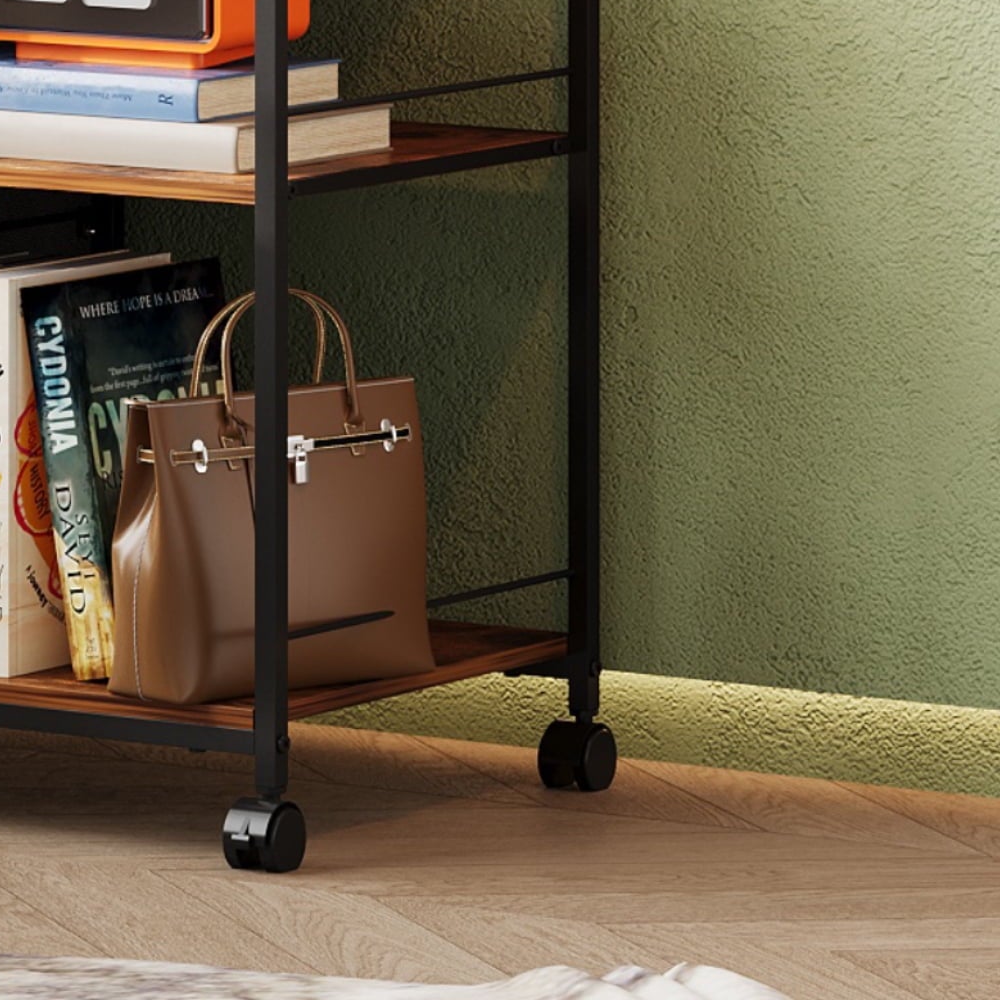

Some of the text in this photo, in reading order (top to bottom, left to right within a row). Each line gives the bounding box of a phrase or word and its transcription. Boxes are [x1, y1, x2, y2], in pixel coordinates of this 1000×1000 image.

[79, 300, 120, 319] WHERE
[122, 294, 152, 313] HOPE
[153, 292, 164, 306] IS
[164, 291, 172, 305] A
[34, 316, 78, 455] CYDONIA
[30, 465, 52, 520] HISTORY
[55, 486, 86, 614] DAVID
[76, 514, 96, 579] SEYI
